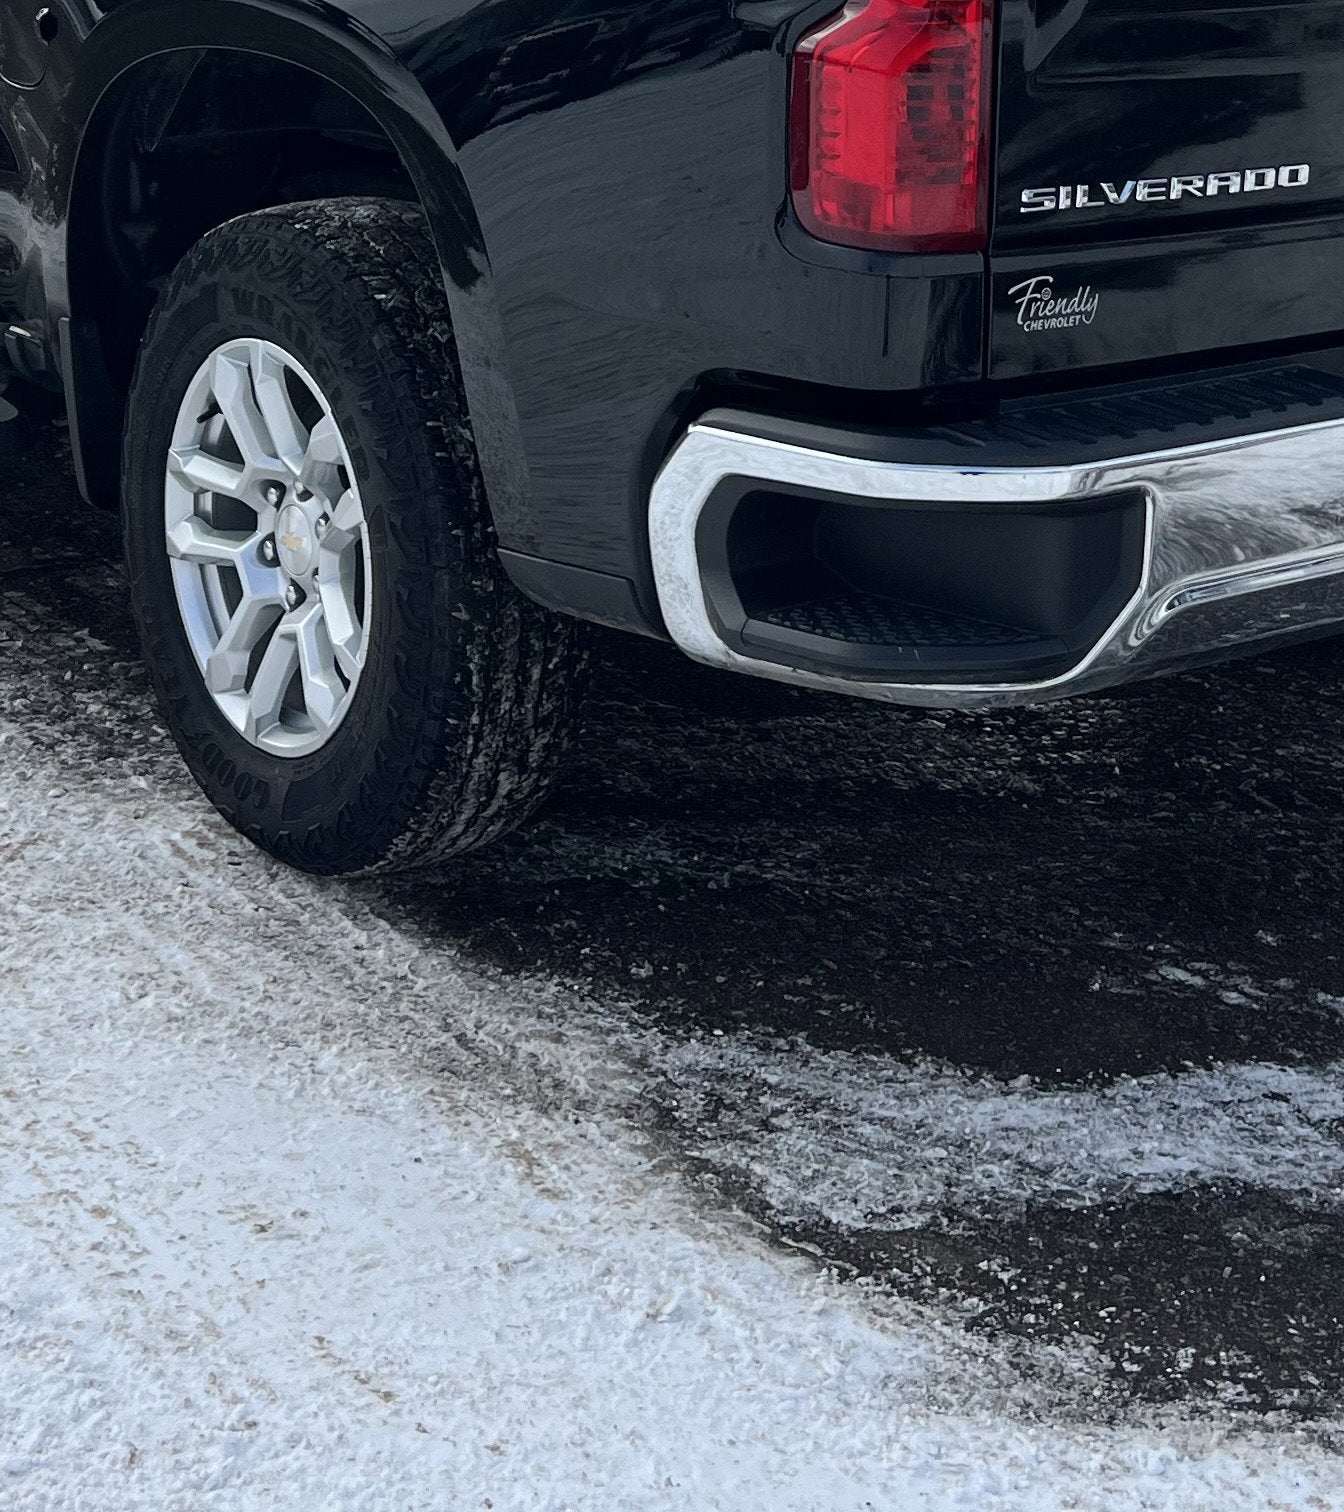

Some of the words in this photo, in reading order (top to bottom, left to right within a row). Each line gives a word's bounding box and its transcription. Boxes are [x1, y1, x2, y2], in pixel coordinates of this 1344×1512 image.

[1020, 163, 1310, 213] SILVERADO
[1007, 275, 1099, 325] Friendly
[1023, 315, 1082, 332] CHEVROLET
